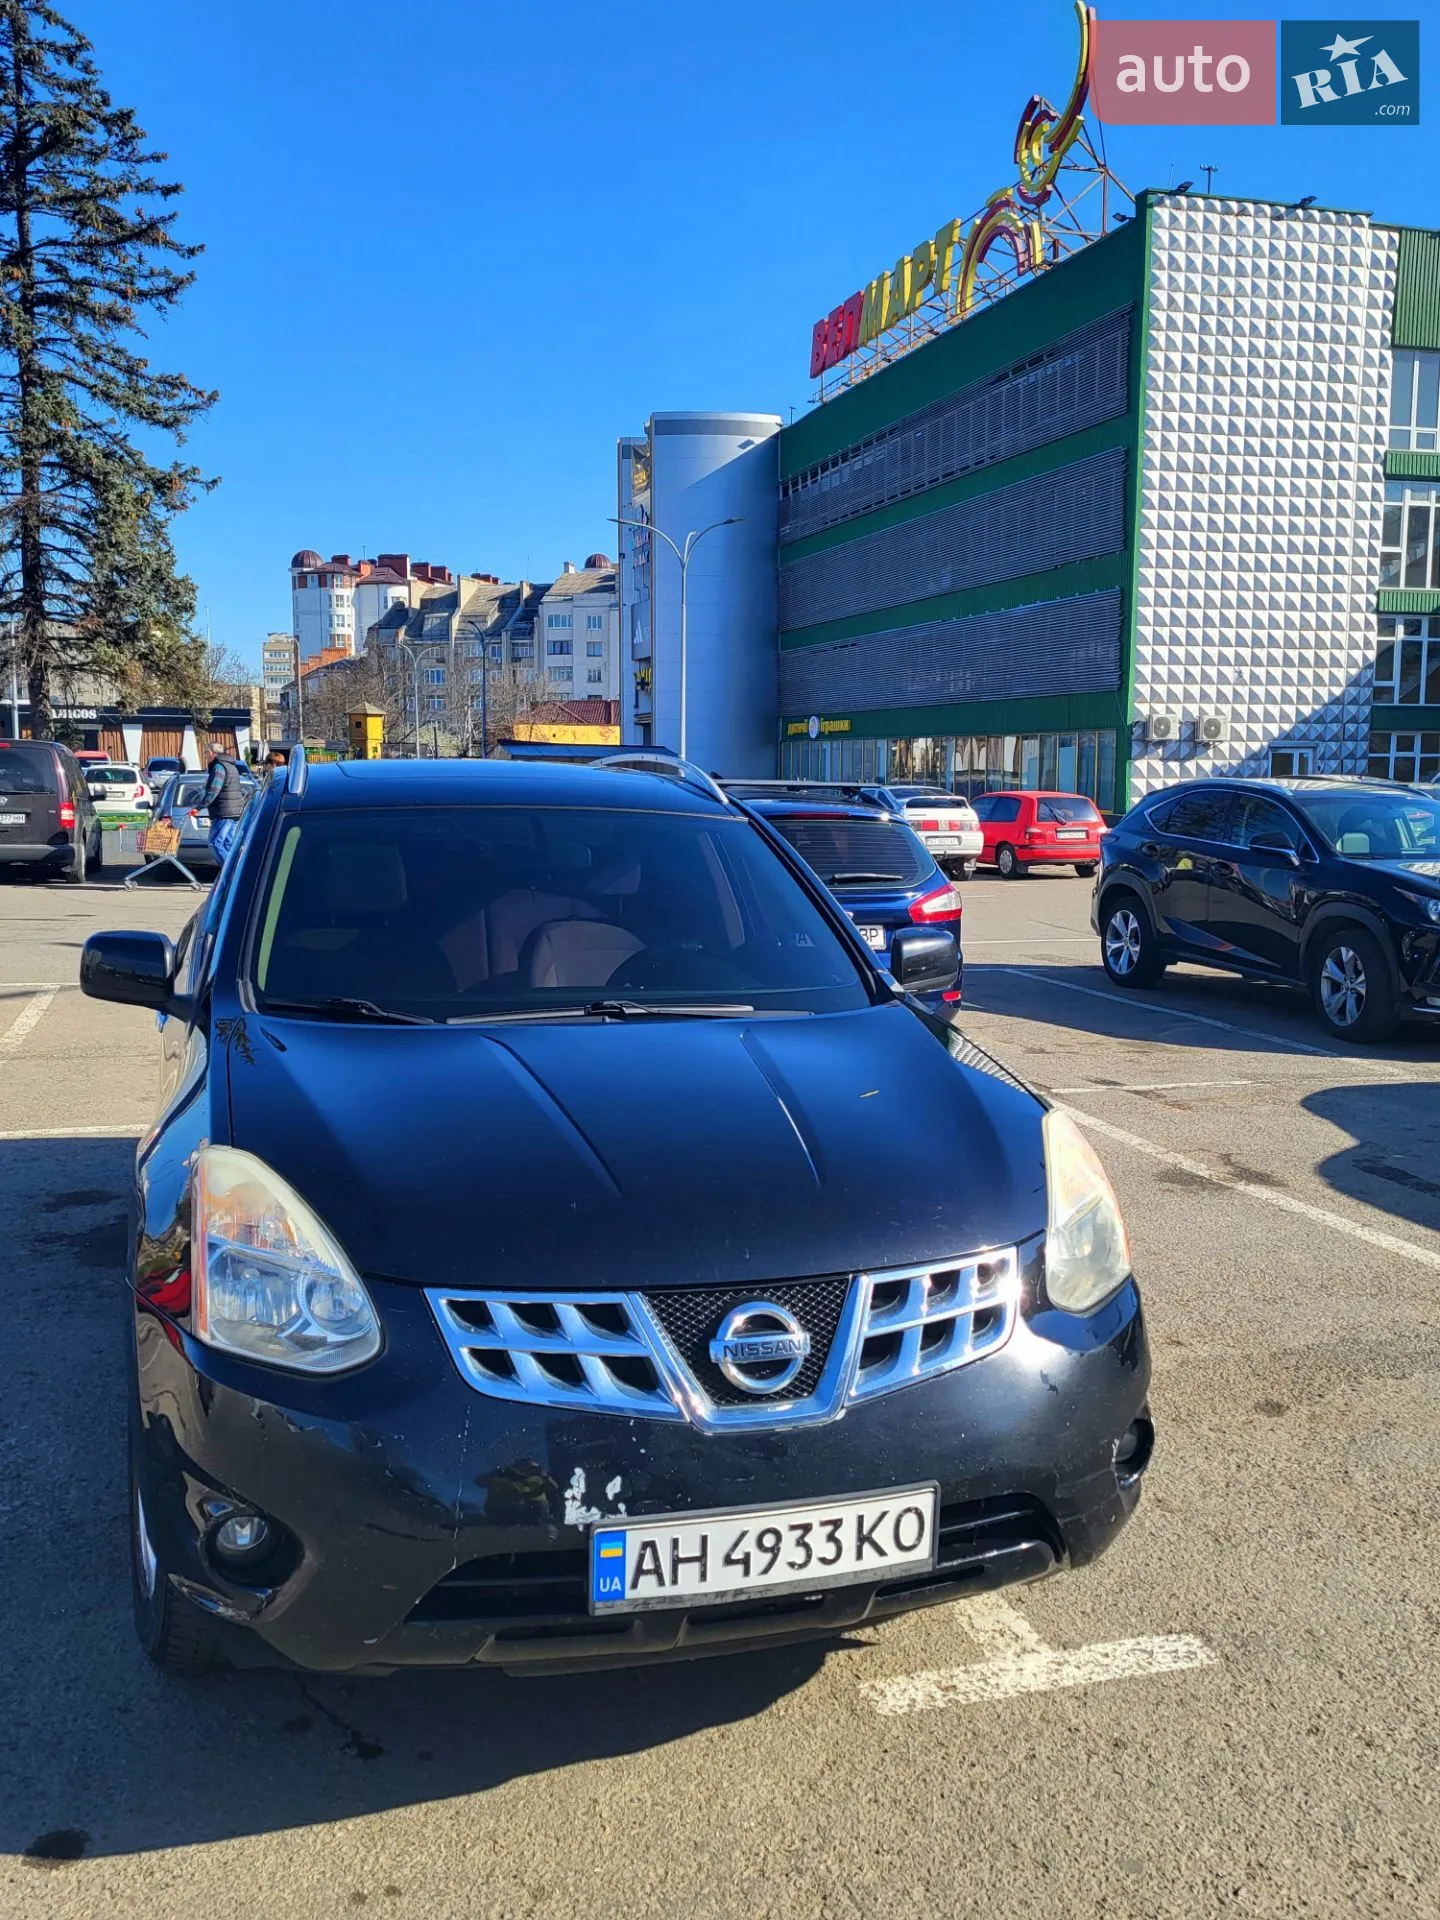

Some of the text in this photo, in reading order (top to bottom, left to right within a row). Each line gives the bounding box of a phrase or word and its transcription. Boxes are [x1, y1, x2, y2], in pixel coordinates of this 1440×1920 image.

[722, 1338, 801, 1358] NISSAN
[629, 1505, 926, 1591] AH 4933 KO
[599, 1576, 623, 1593] UA
